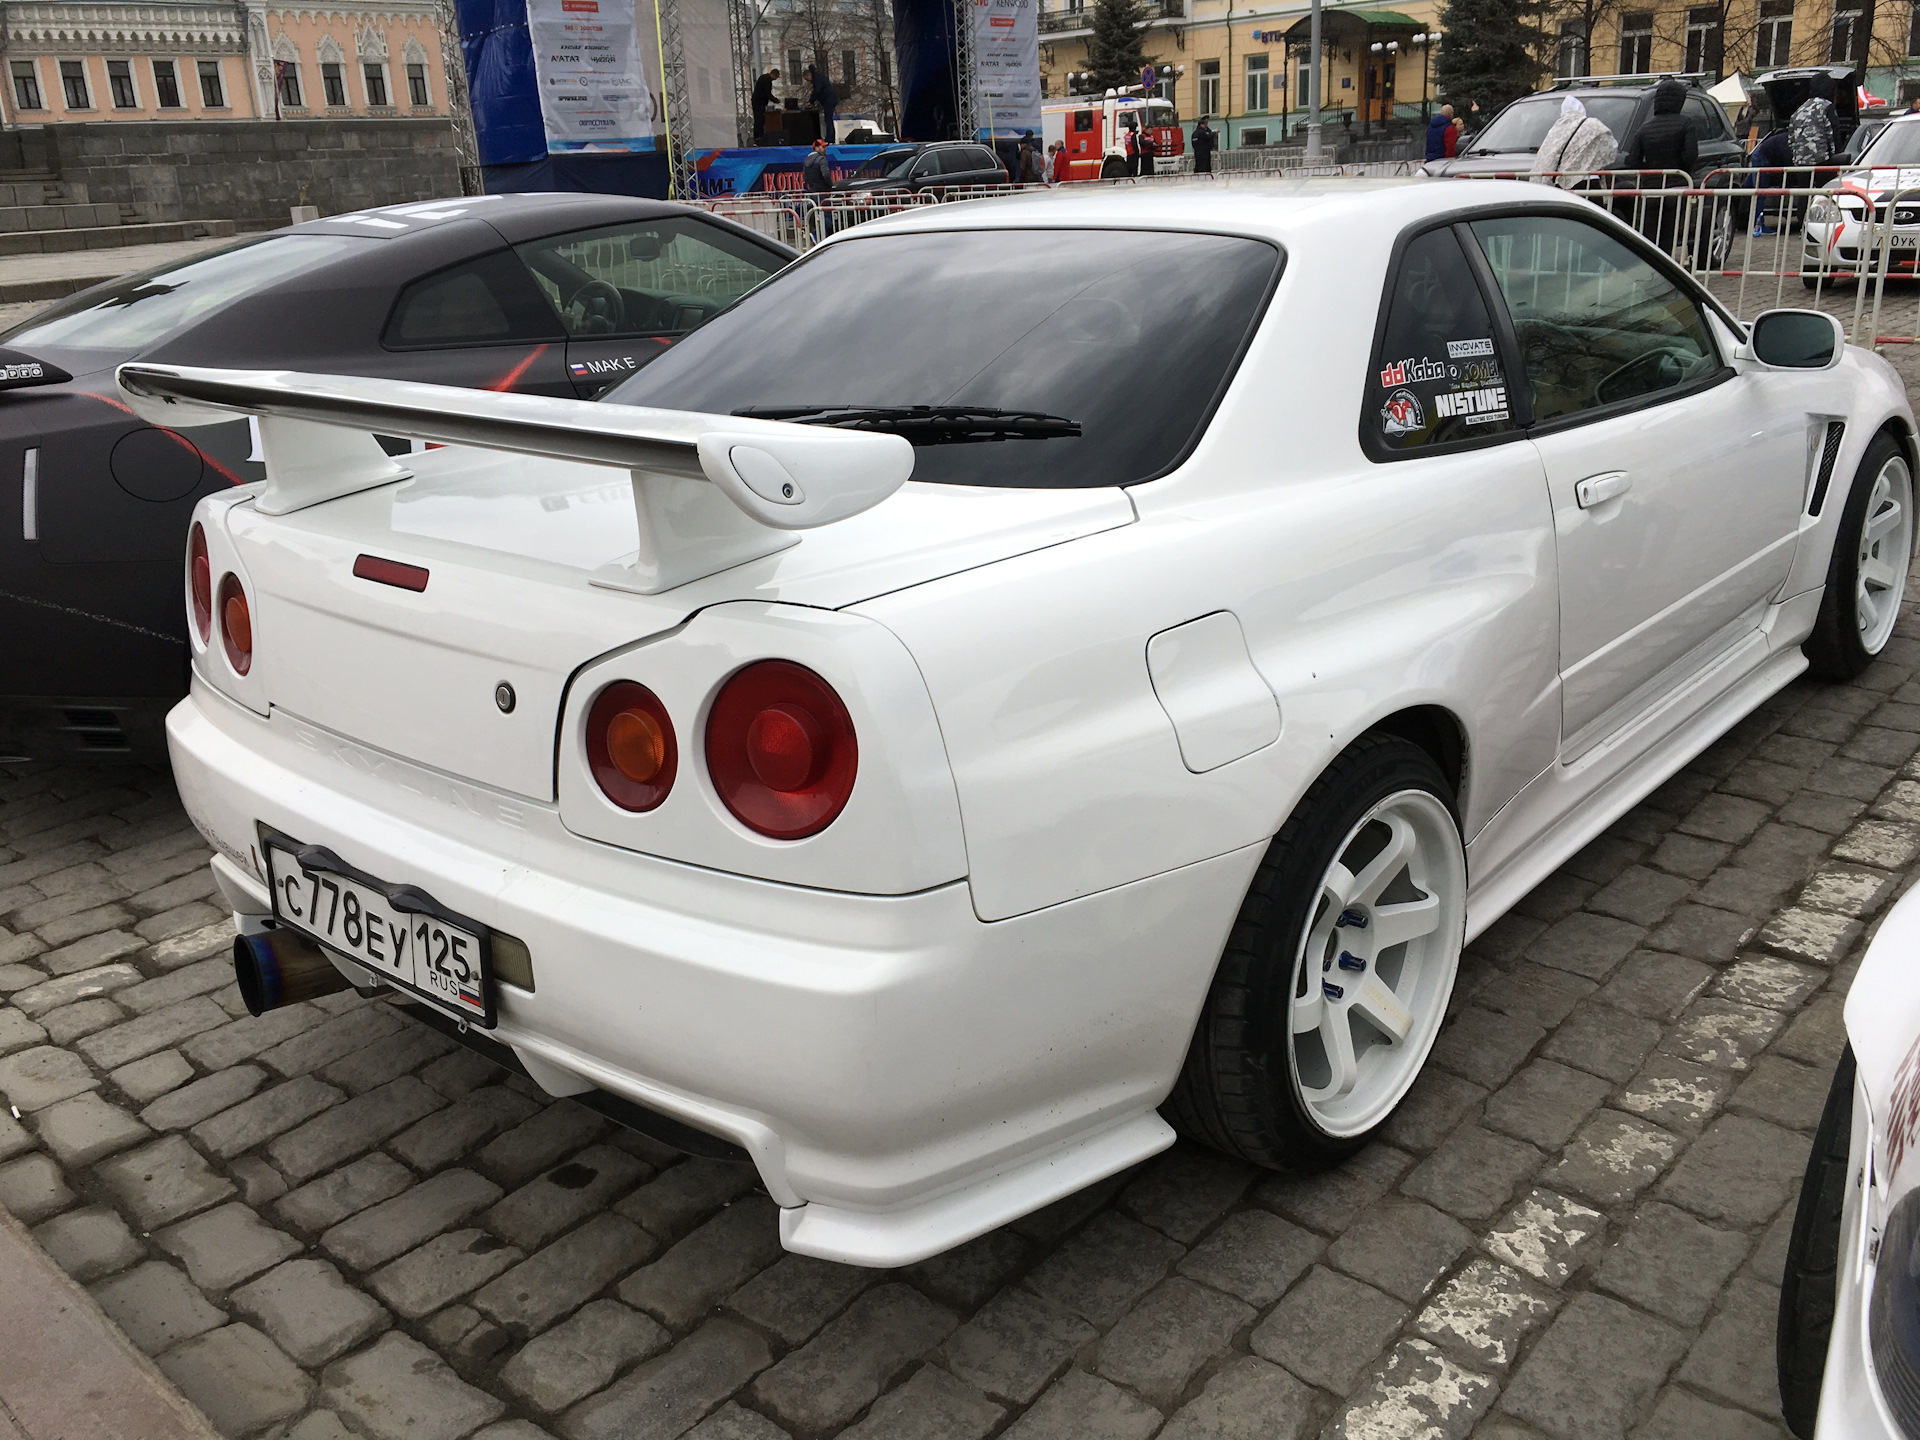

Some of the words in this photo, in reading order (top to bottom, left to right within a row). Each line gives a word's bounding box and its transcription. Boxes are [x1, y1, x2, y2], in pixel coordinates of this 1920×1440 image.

[1449, 341, 1491, 352] INNOVATE
[1381, 357, 1445, 388] ddKaba
[1435, 387, 1507, 418] NISTUNE
[416, 921, 471, 983] 125
[430, 971, 458, 996] RUS
